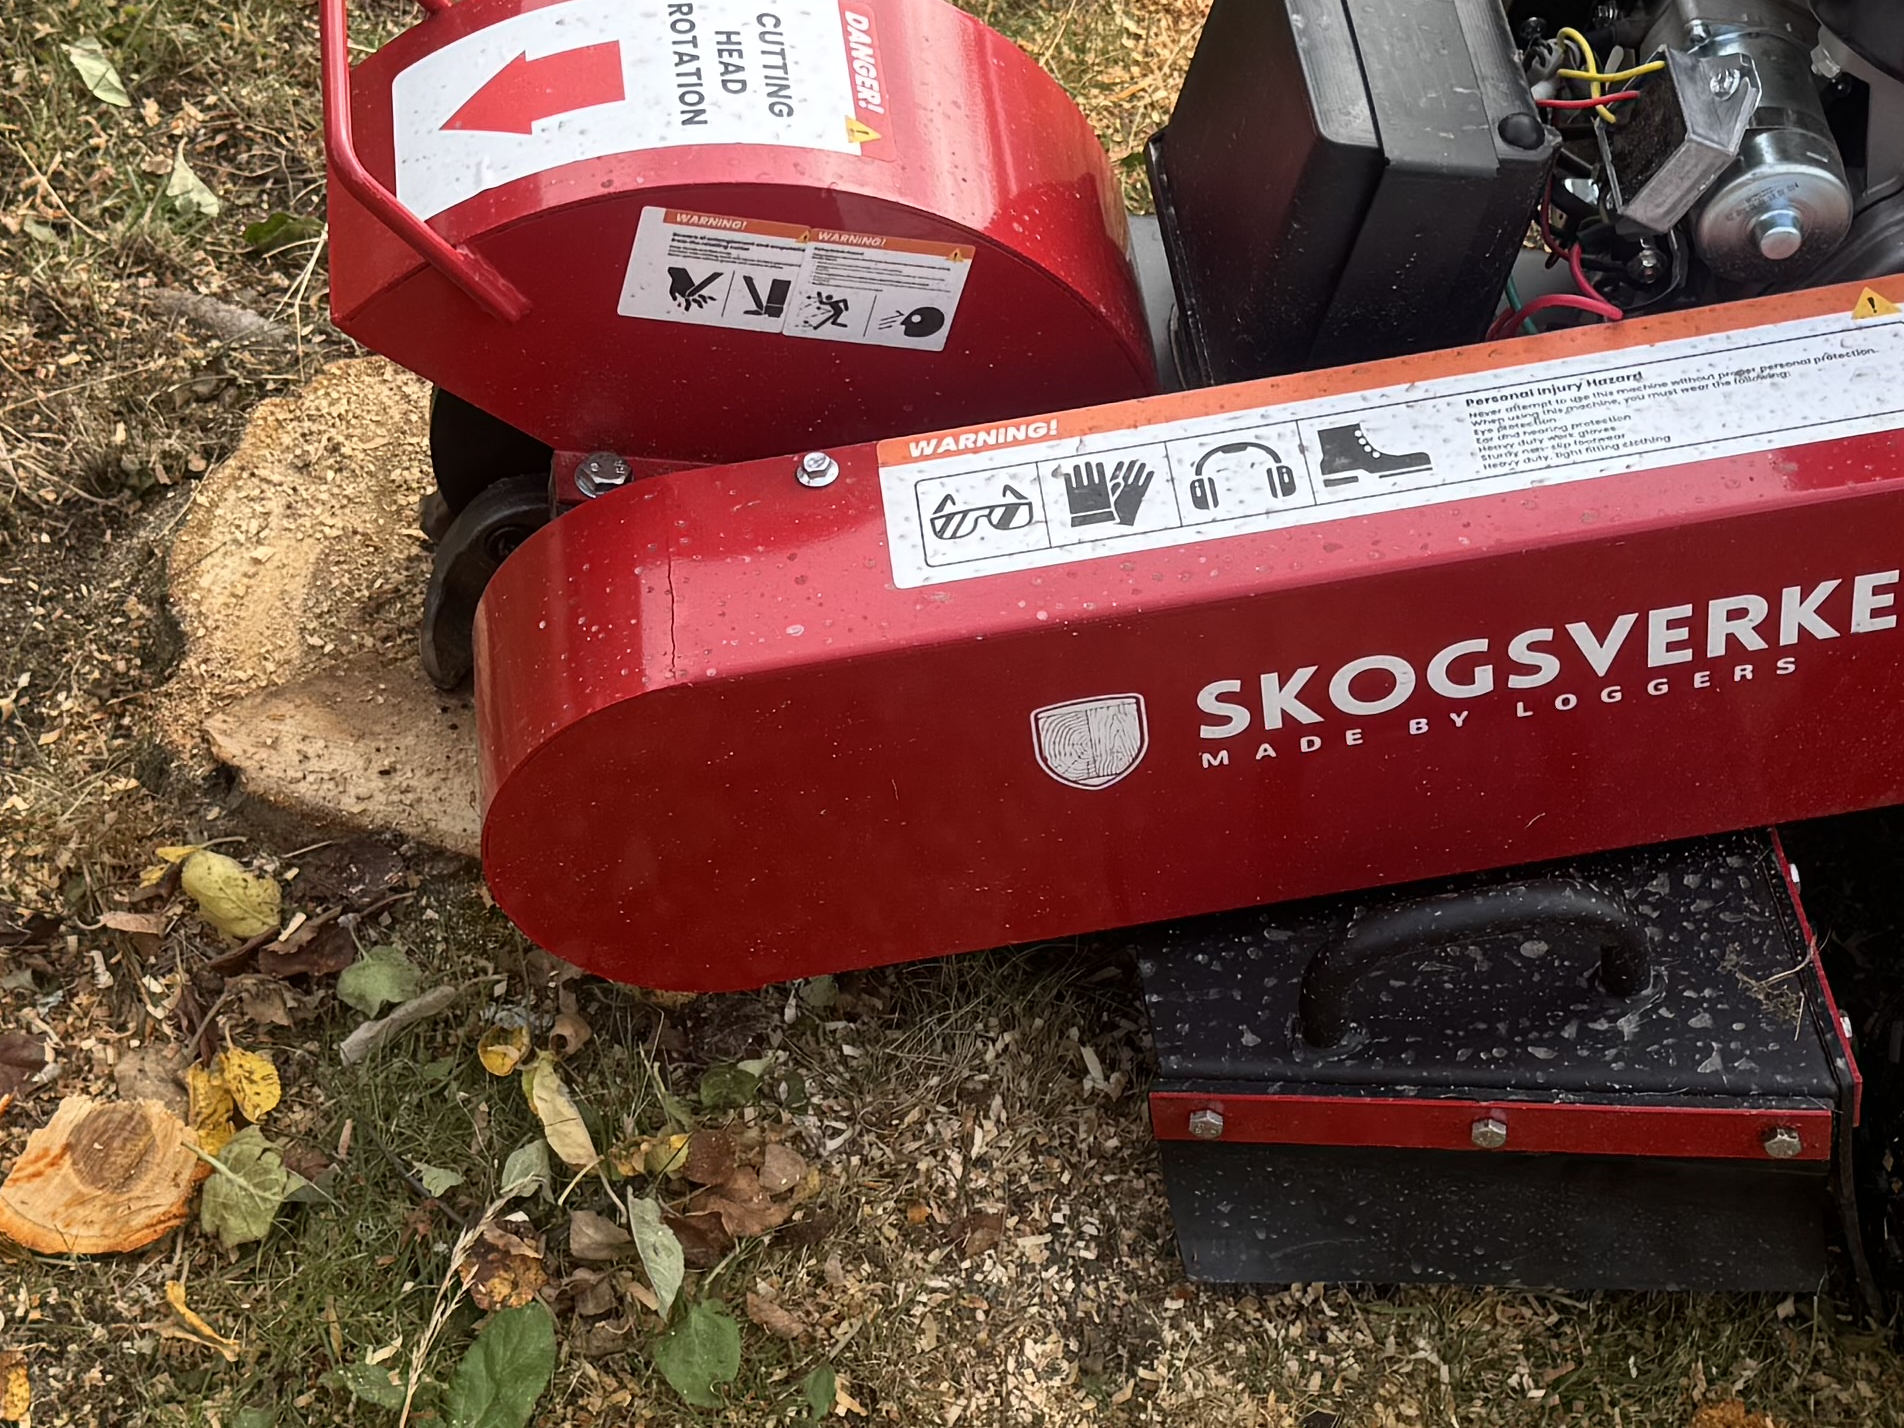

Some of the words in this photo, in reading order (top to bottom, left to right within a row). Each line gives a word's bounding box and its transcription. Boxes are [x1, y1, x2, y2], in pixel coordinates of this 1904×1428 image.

[667, 2, 708, 126] ROTATION
[714, 30, 747, 94] HEAD
[756, 12, 794, 118] CUTTING
[845, 10, 885, 114] DANGER!
[674, 212, 747, 230] WARNING!
[817, 230, 886, 248] WARNING!
[1465, 388, 1533, 407] Personal
[1537, 379, 1583, 398] Injury
[1587, 370, 1641, 388] Hazard
[909, 419, 1058, 458] WARNING!
[1200, 728, 1363, 769] MADE
[1408, 709, 1470, 735] BY
[1515, 656, 1798, 717] LOGGERS
